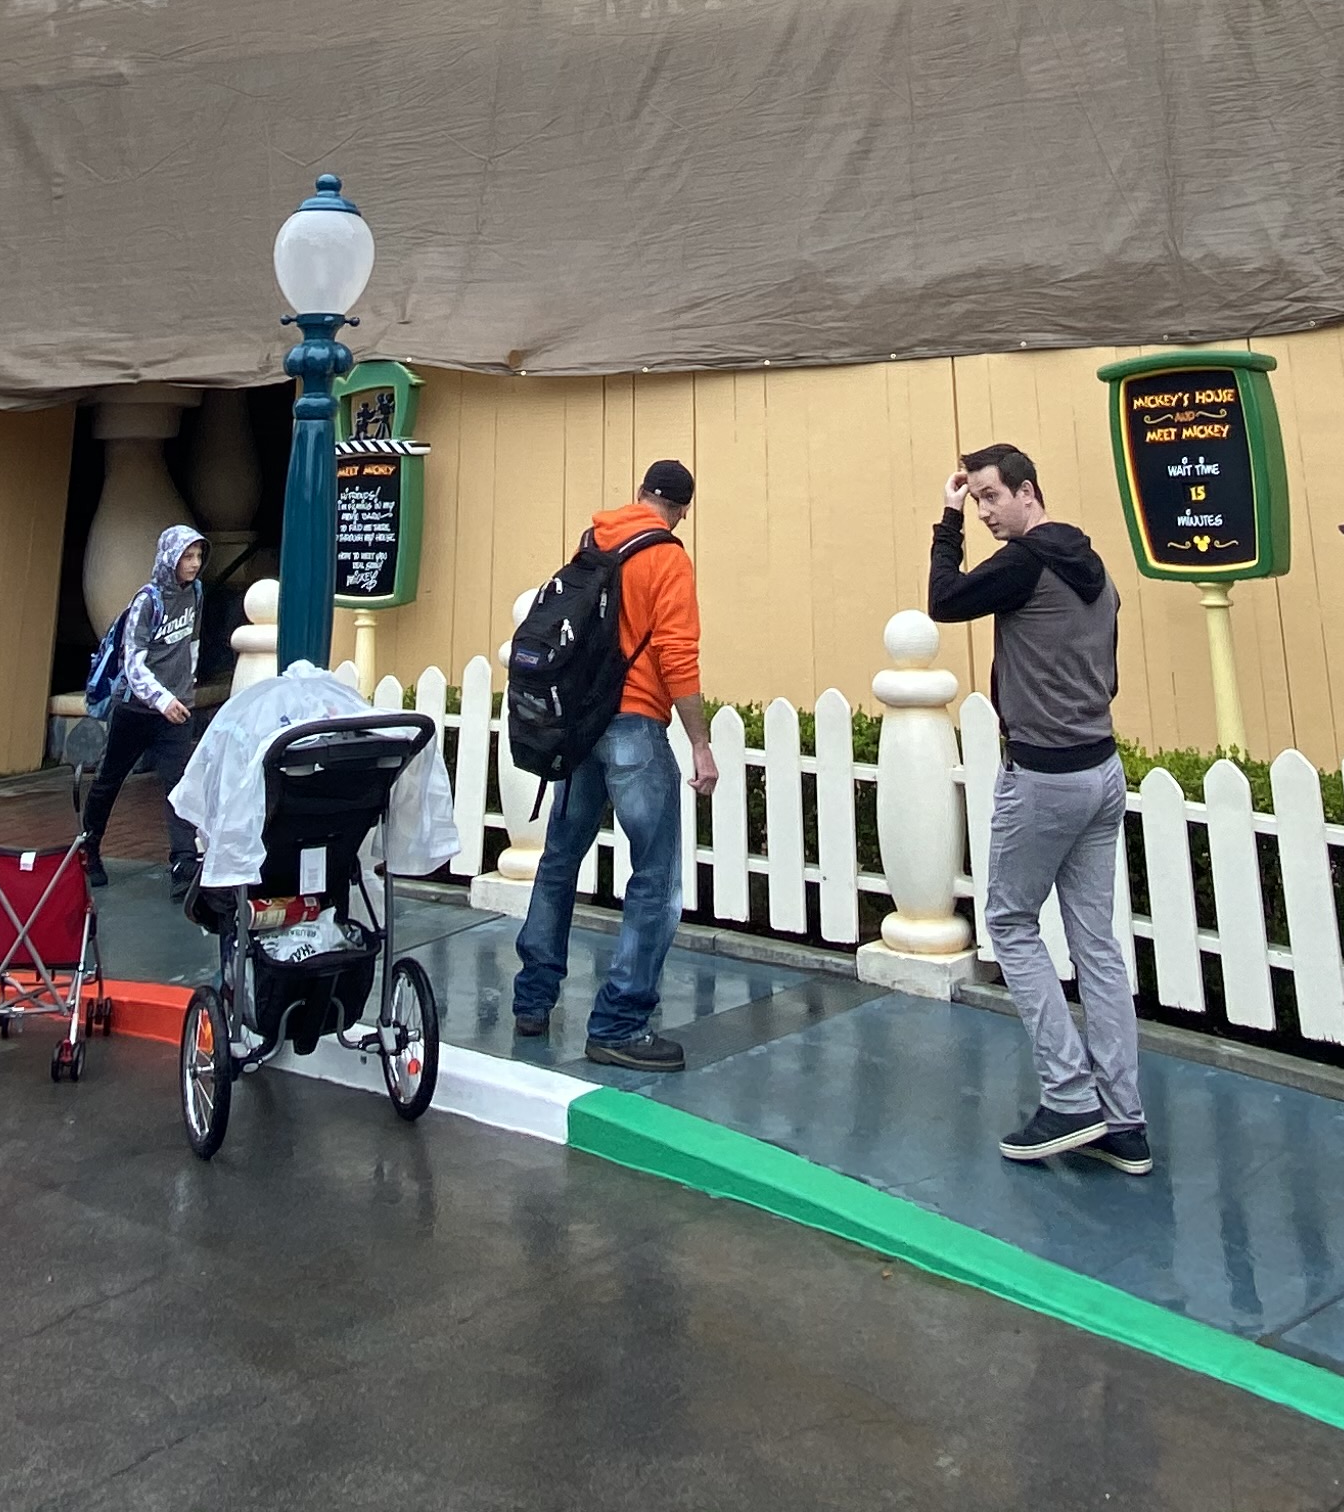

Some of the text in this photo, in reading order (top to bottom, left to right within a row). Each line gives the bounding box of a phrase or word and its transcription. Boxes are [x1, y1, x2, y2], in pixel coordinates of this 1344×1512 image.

[1133, 389, 1235, 410] MICKEY'S HOUSE
[1174, 410, 1196, 423] AND
[1145, 424, 1229, 443] MEET MICKEY
[1167, 456, 1220, 477] WAIT TIME
[1190, 485, 1206, 501] 15
